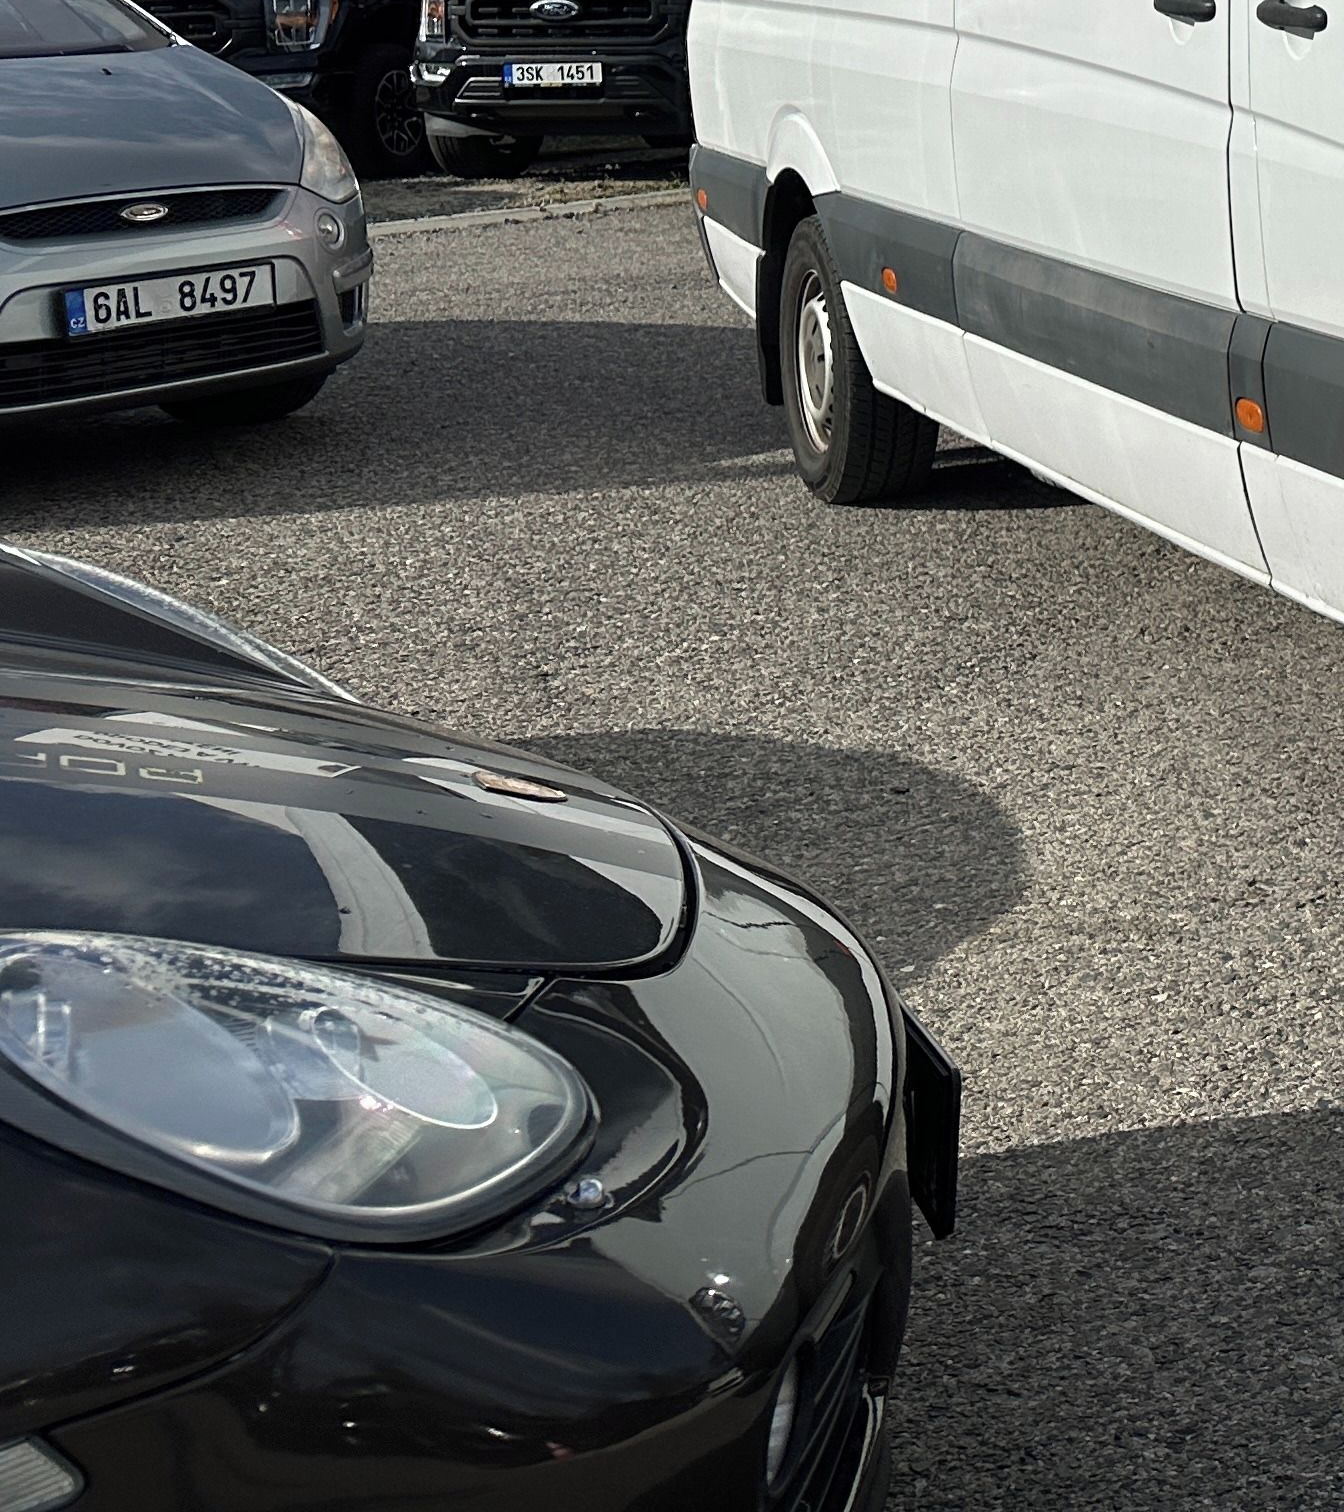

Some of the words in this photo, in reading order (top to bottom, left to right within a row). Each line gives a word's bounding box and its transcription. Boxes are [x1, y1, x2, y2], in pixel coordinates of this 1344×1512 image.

[516, 66, 544, 82] 3SK
[557, 64, 594, 81] 1451
[93, 286, 153, 324] 6AL
[178, 270, 257, 312] 8497
[70, 317, 85, 328] CZ
